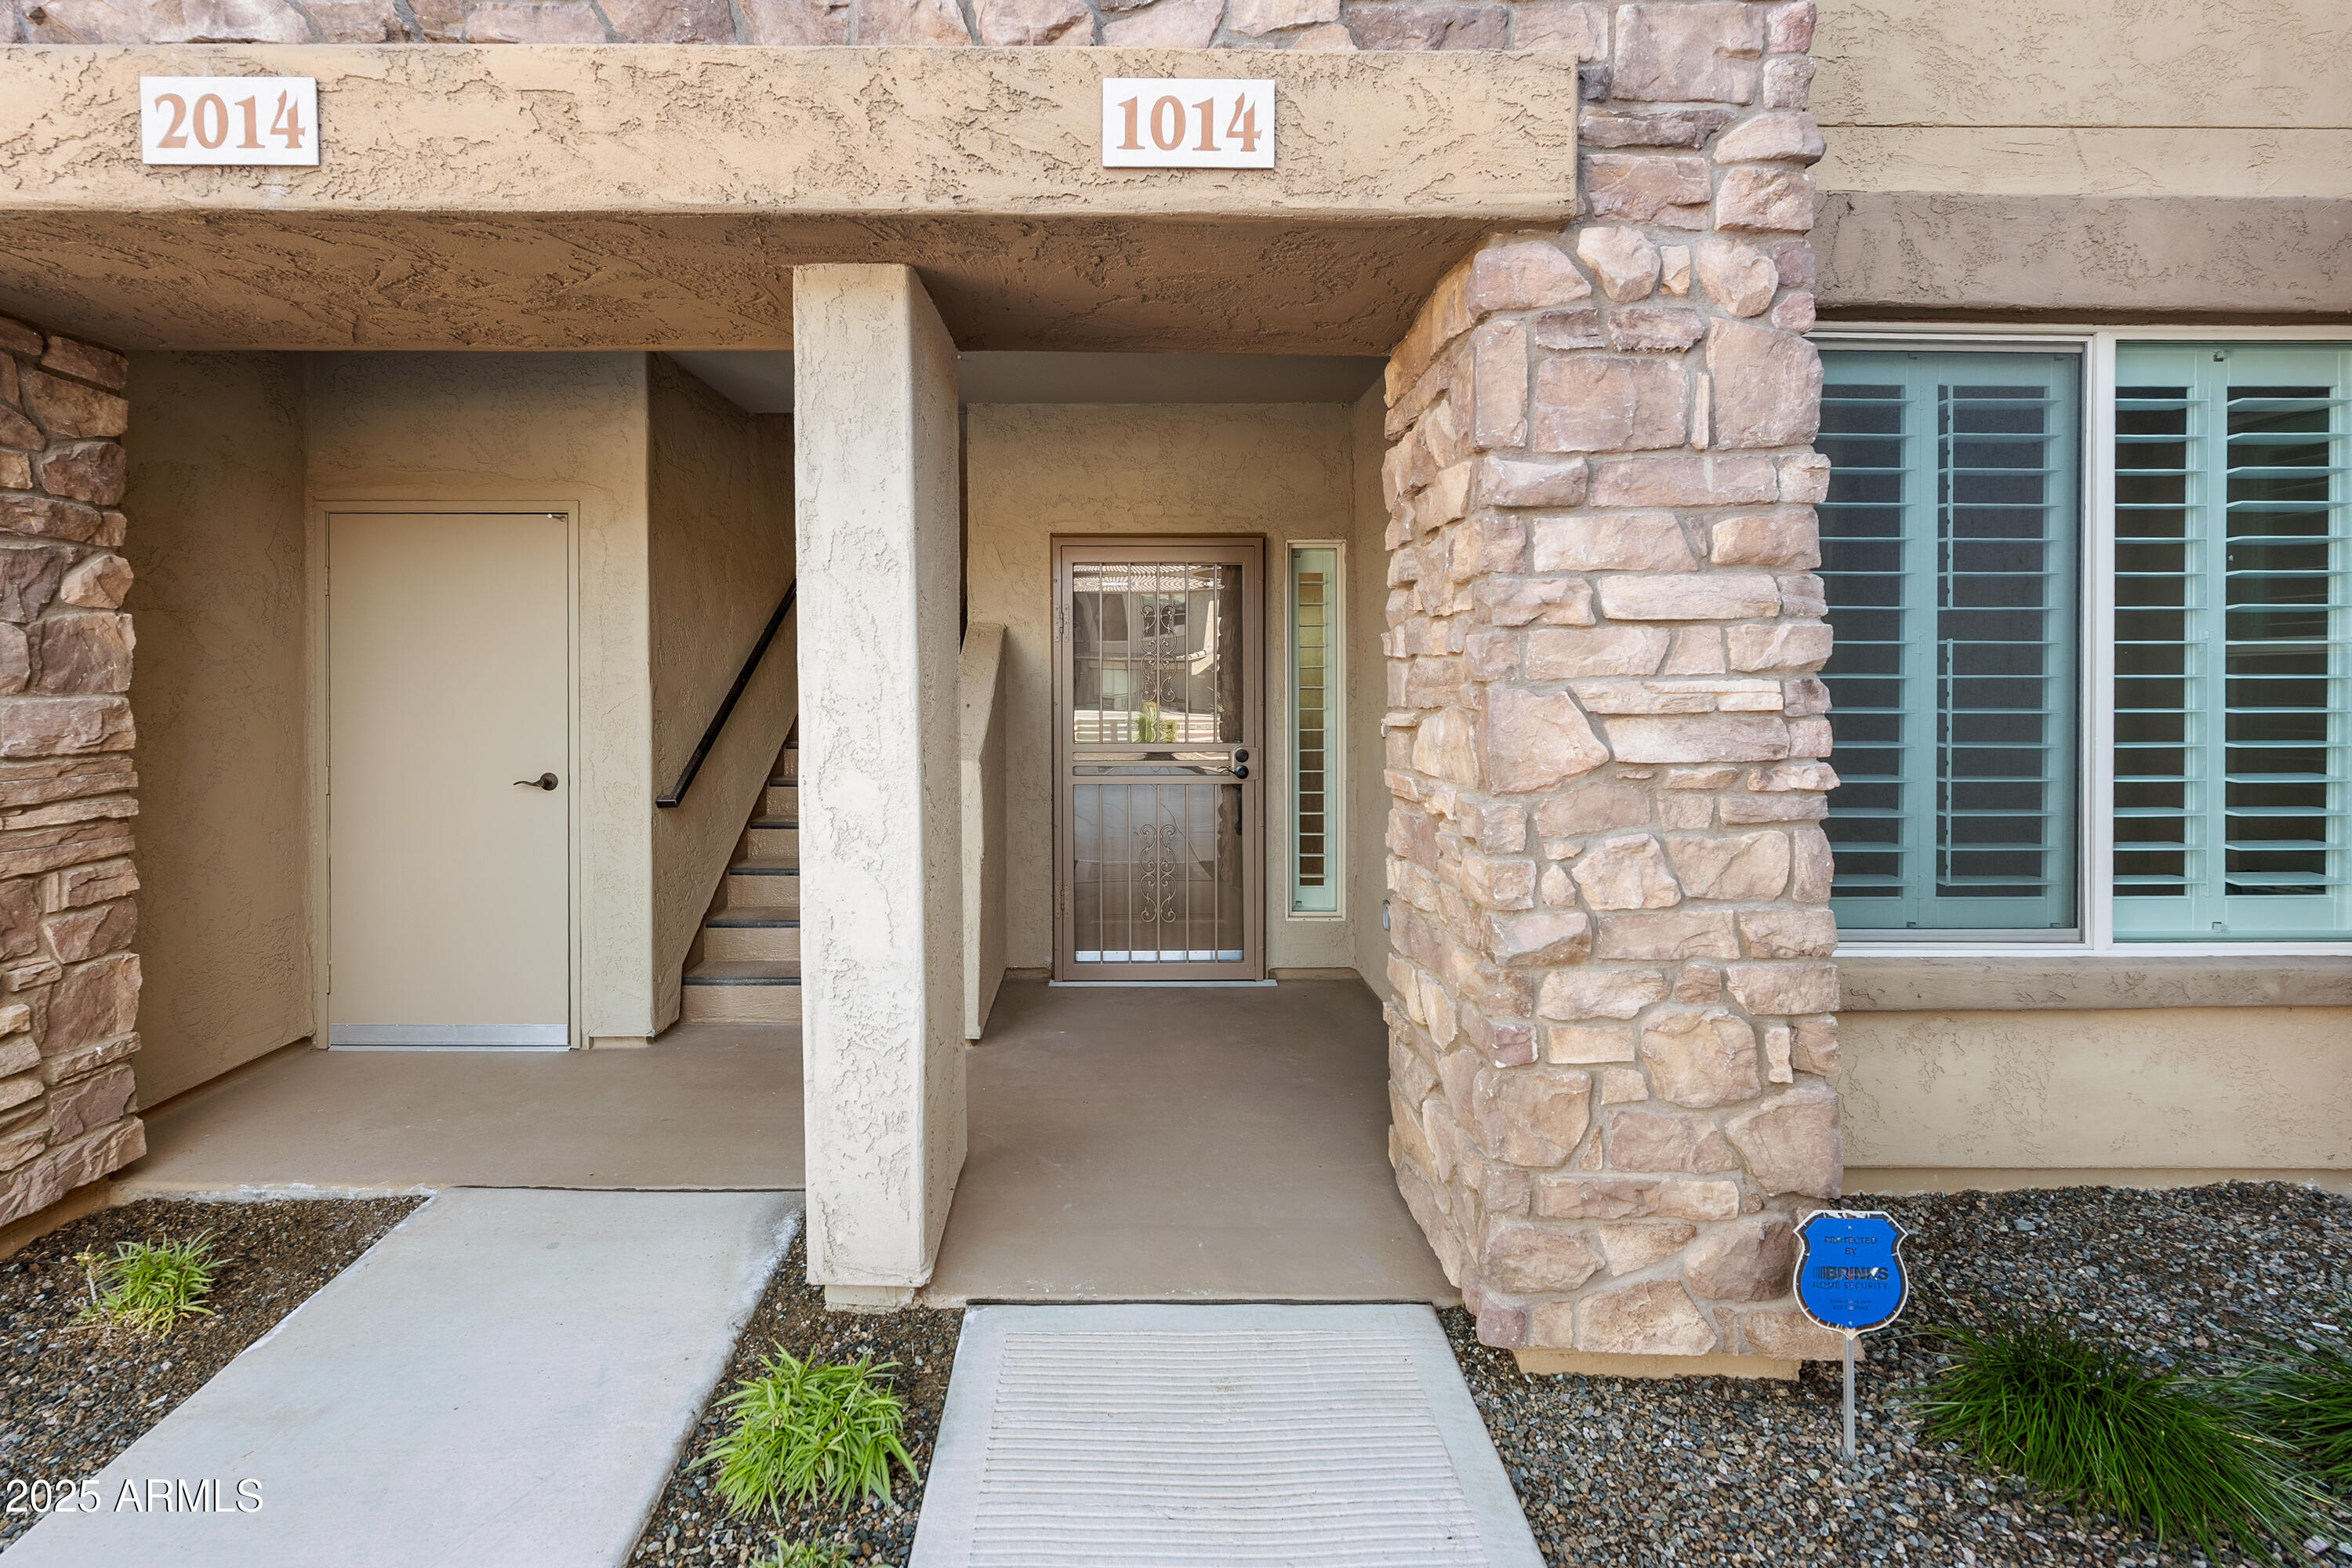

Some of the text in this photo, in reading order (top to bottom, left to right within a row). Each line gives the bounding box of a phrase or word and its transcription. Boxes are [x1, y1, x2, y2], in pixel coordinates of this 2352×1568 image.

[154, 89, 306, 150] 2014
[1116, 92, 1261, 152] 1014
[1825, 1266, 1889, 1280] BRINKS
